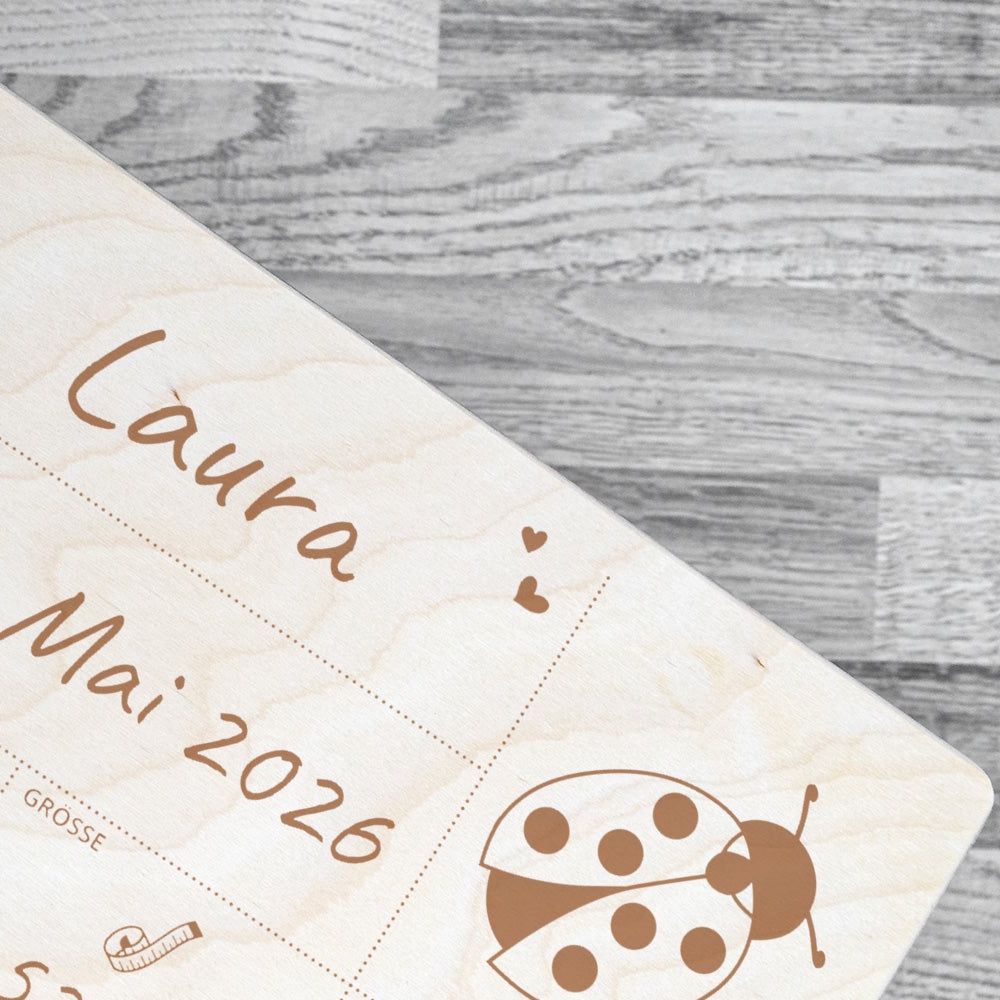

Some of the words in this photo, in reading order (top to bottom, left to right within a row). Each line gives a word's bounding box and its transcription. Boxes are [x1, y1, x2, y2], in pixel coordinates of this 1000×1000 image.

[67, 329, 358, 583] Laura
[23, 788, 107, 852] GRÖSSE
[183, 712, 396, 865] 2026
